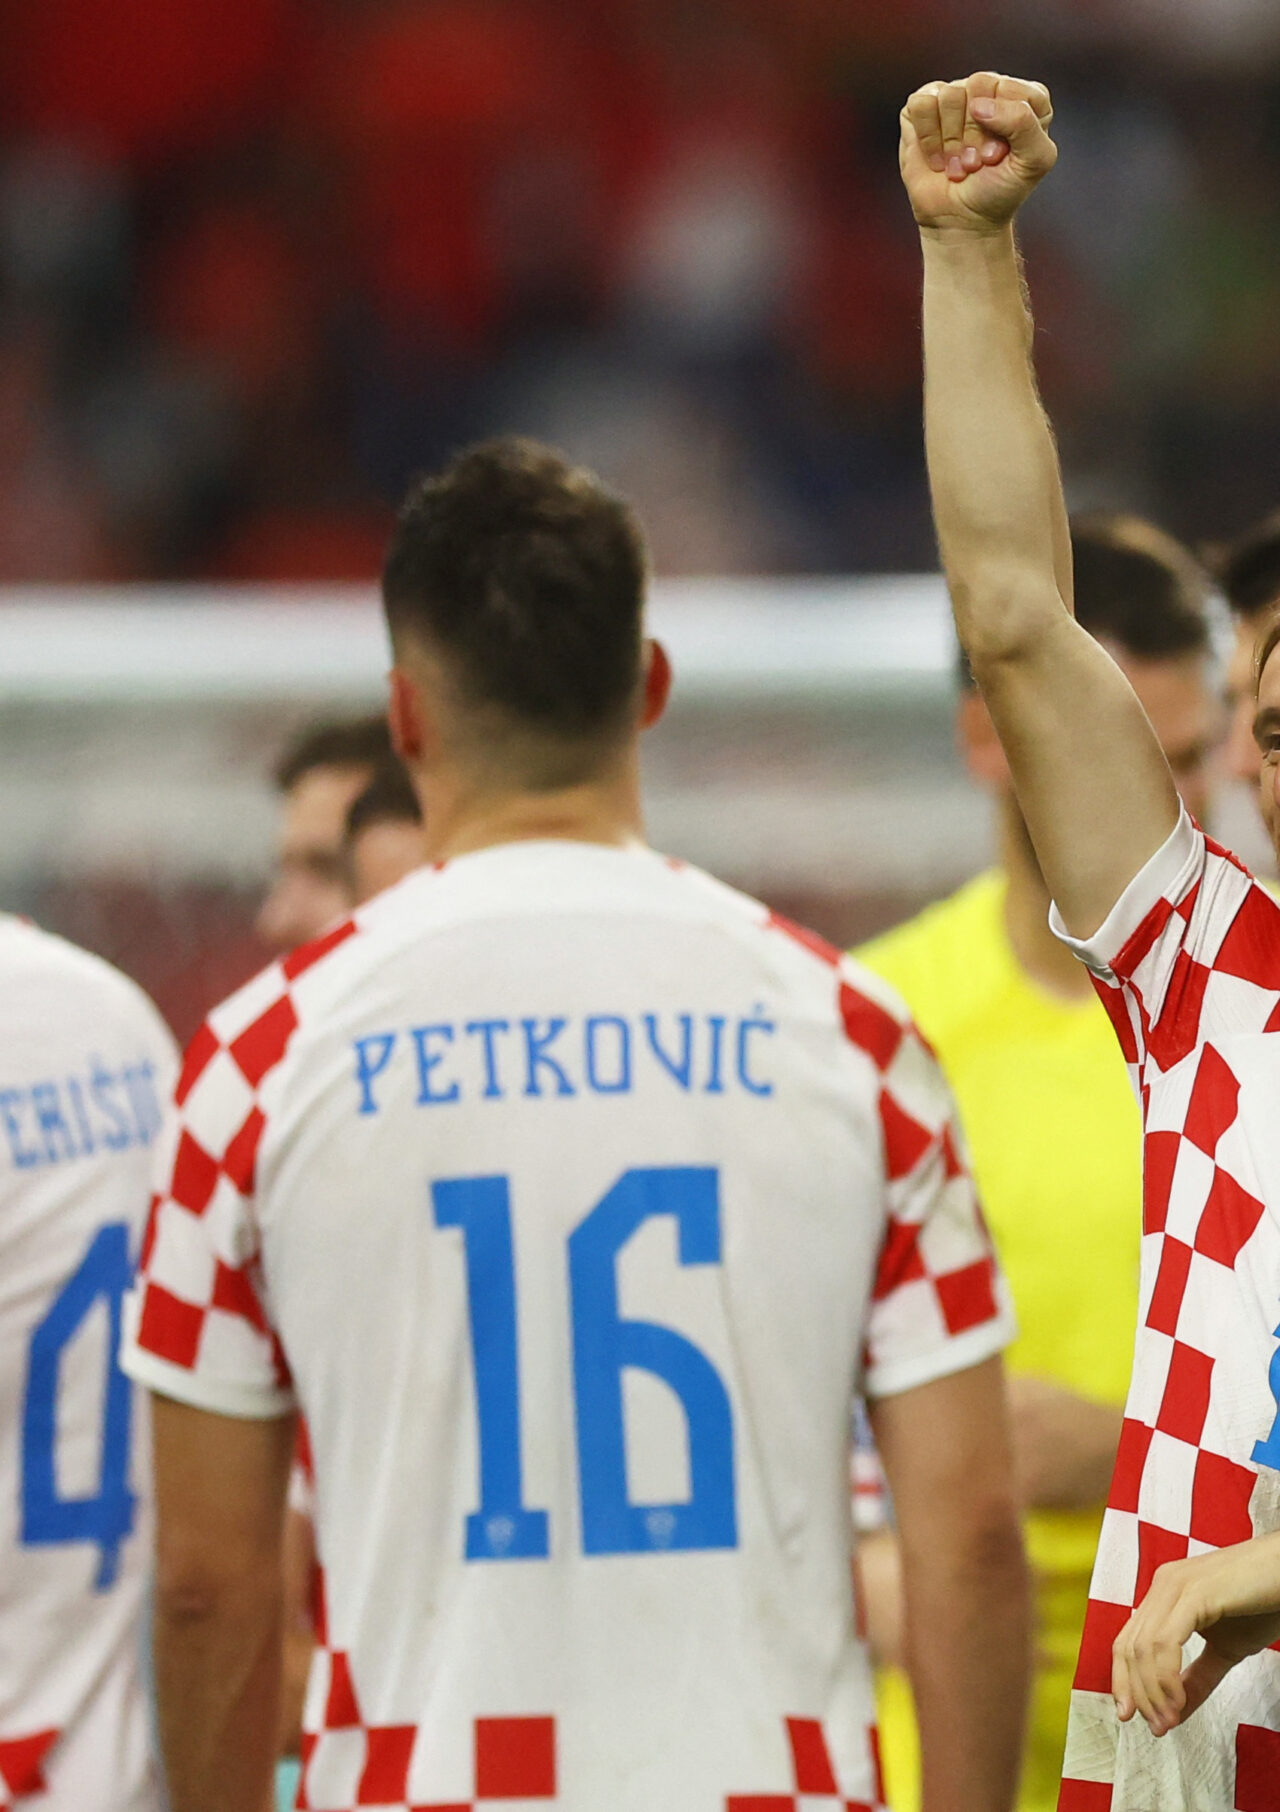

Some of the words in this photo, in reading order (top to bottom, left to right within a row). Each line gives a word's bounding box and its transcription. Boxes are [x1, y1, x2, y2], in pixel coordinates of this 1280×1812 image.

[353, 1003, 776, 1117] PETKOVIĆ
[19, 1218, 138, 1594] 4
[430, 1166, 739, 1561] 16
